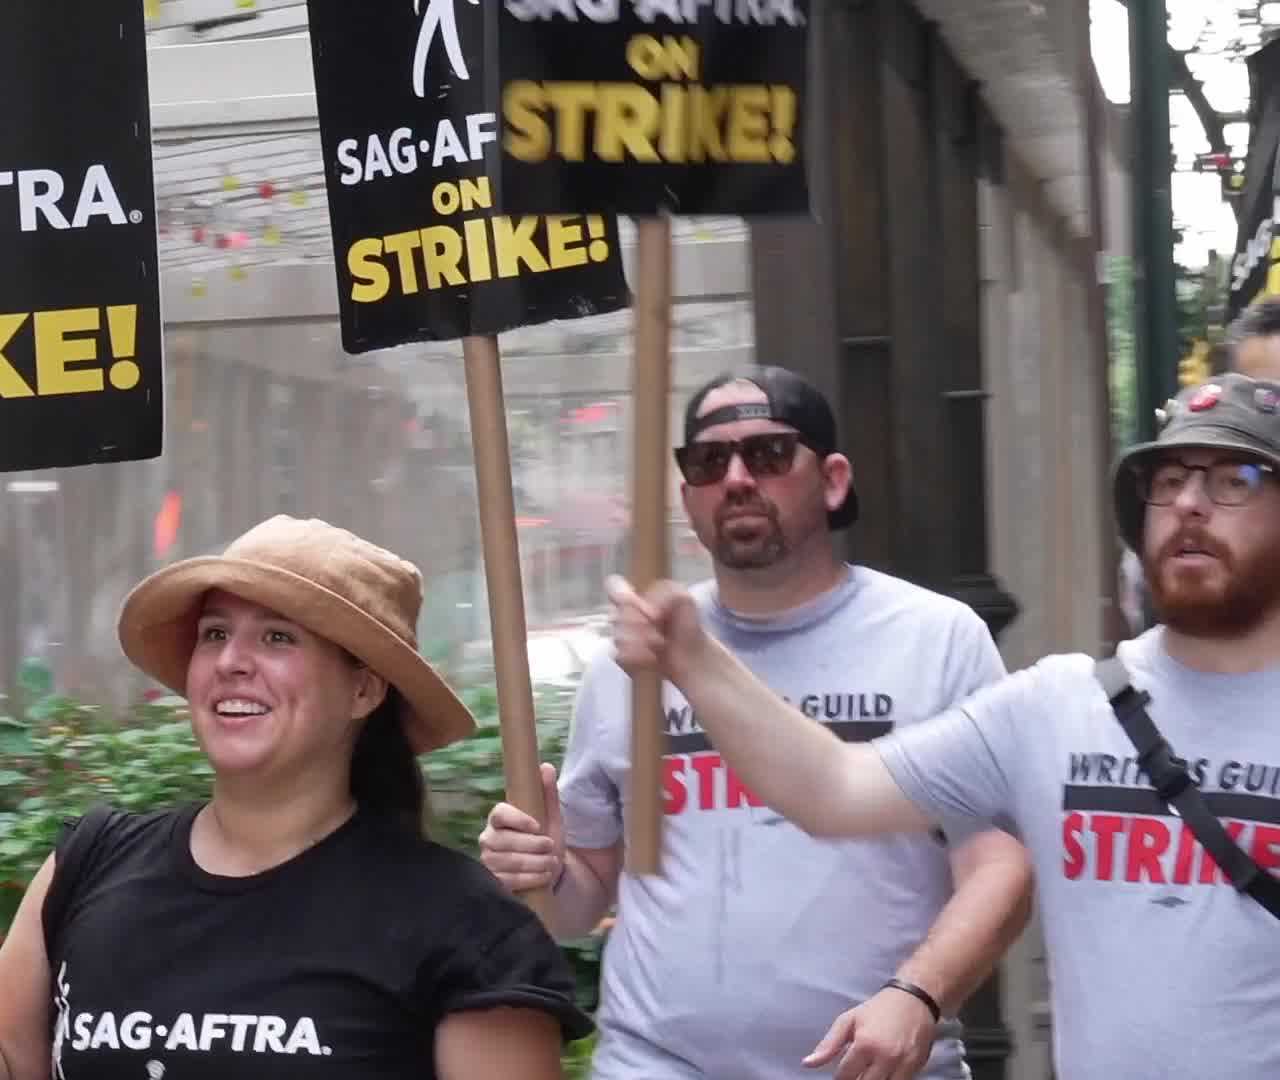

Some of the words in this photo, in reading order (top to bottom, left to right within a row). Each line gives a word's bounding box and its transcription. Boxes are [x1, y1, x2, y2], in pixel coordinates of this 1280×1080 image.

[625, 33, 702, 80] ON
[502, 80, 797, 164] STRIKE!
[336, 112, 496, 185] SAG·AF
[431, 176, 493, 215] ON
[347, 213, 609, 303] STRIKE!
[799, 692, 894, 720] GUILD
[1217, 759, 1280, 795] GUI
